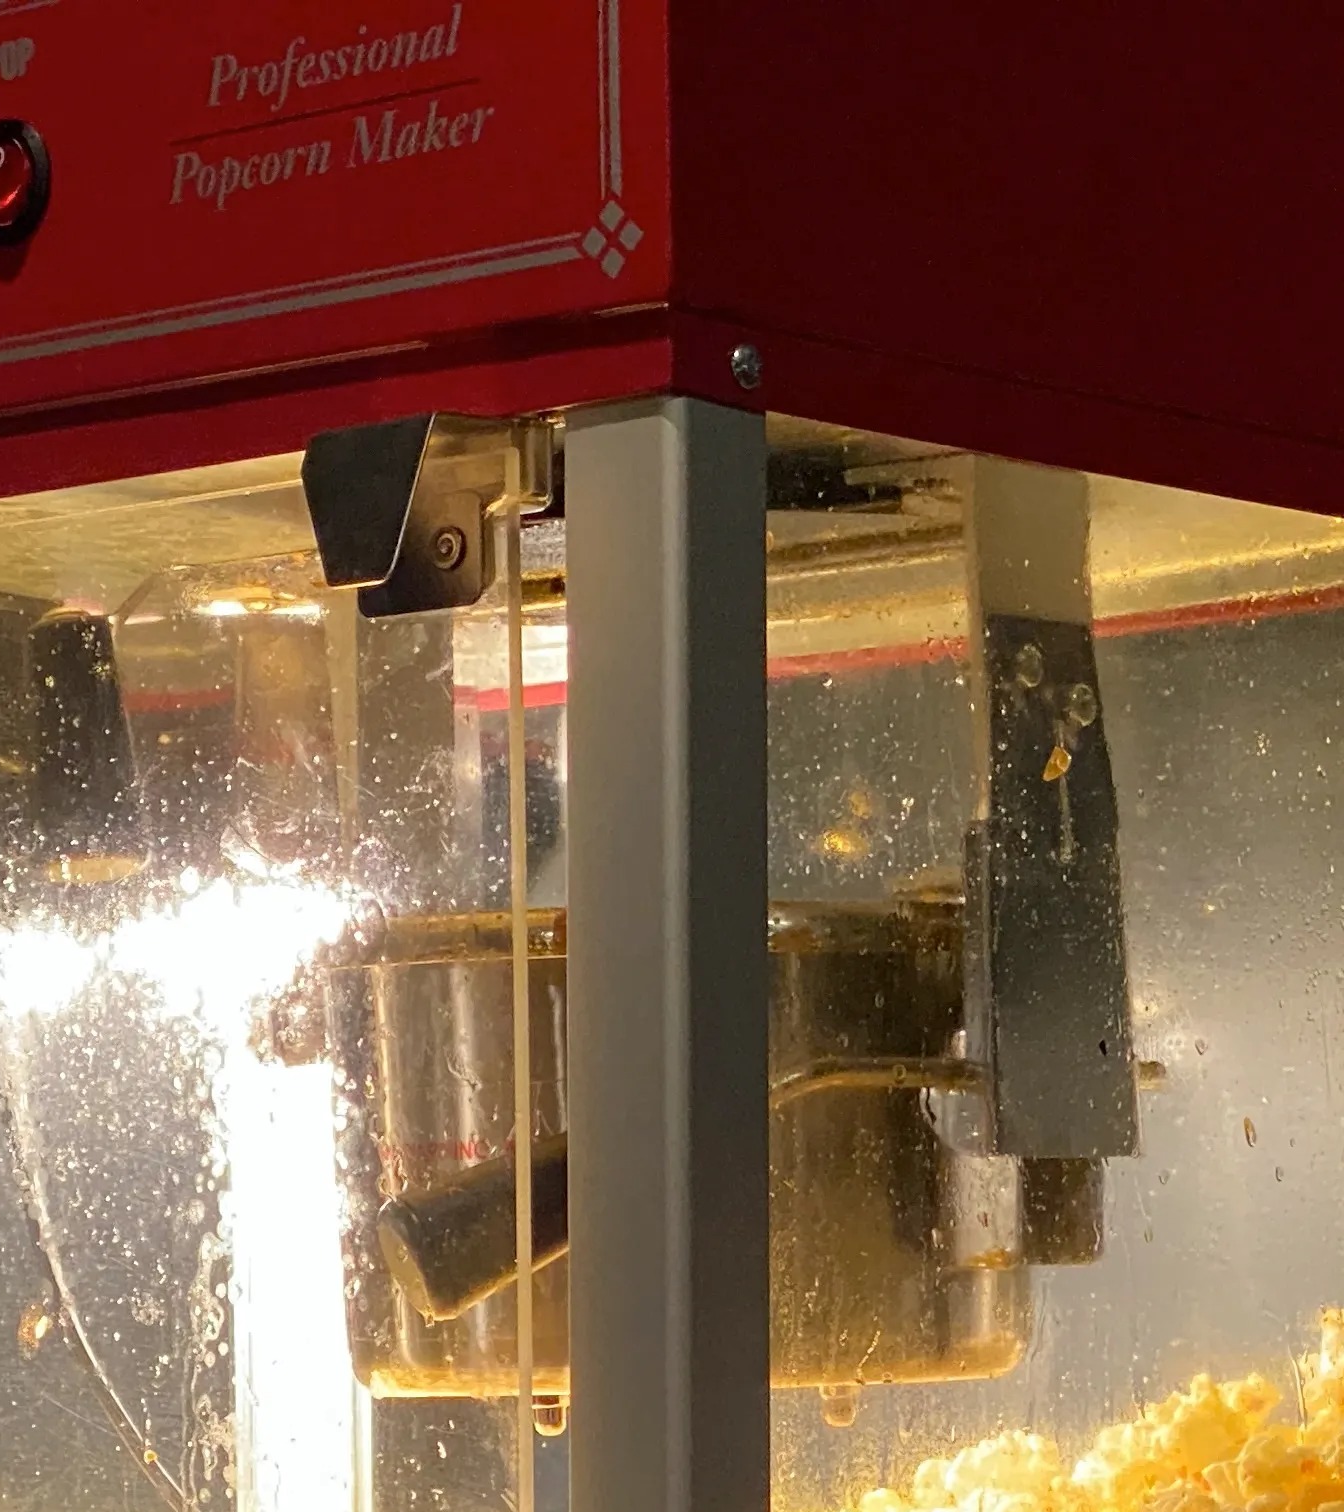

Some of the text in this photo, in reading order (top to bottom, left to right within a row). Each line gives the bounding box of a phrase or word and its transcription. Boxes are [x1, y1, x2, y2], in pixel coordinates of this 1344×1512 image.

[207, 3, 463, 113] Professional
[169, 100, 495, 213] Popcorn Maker
